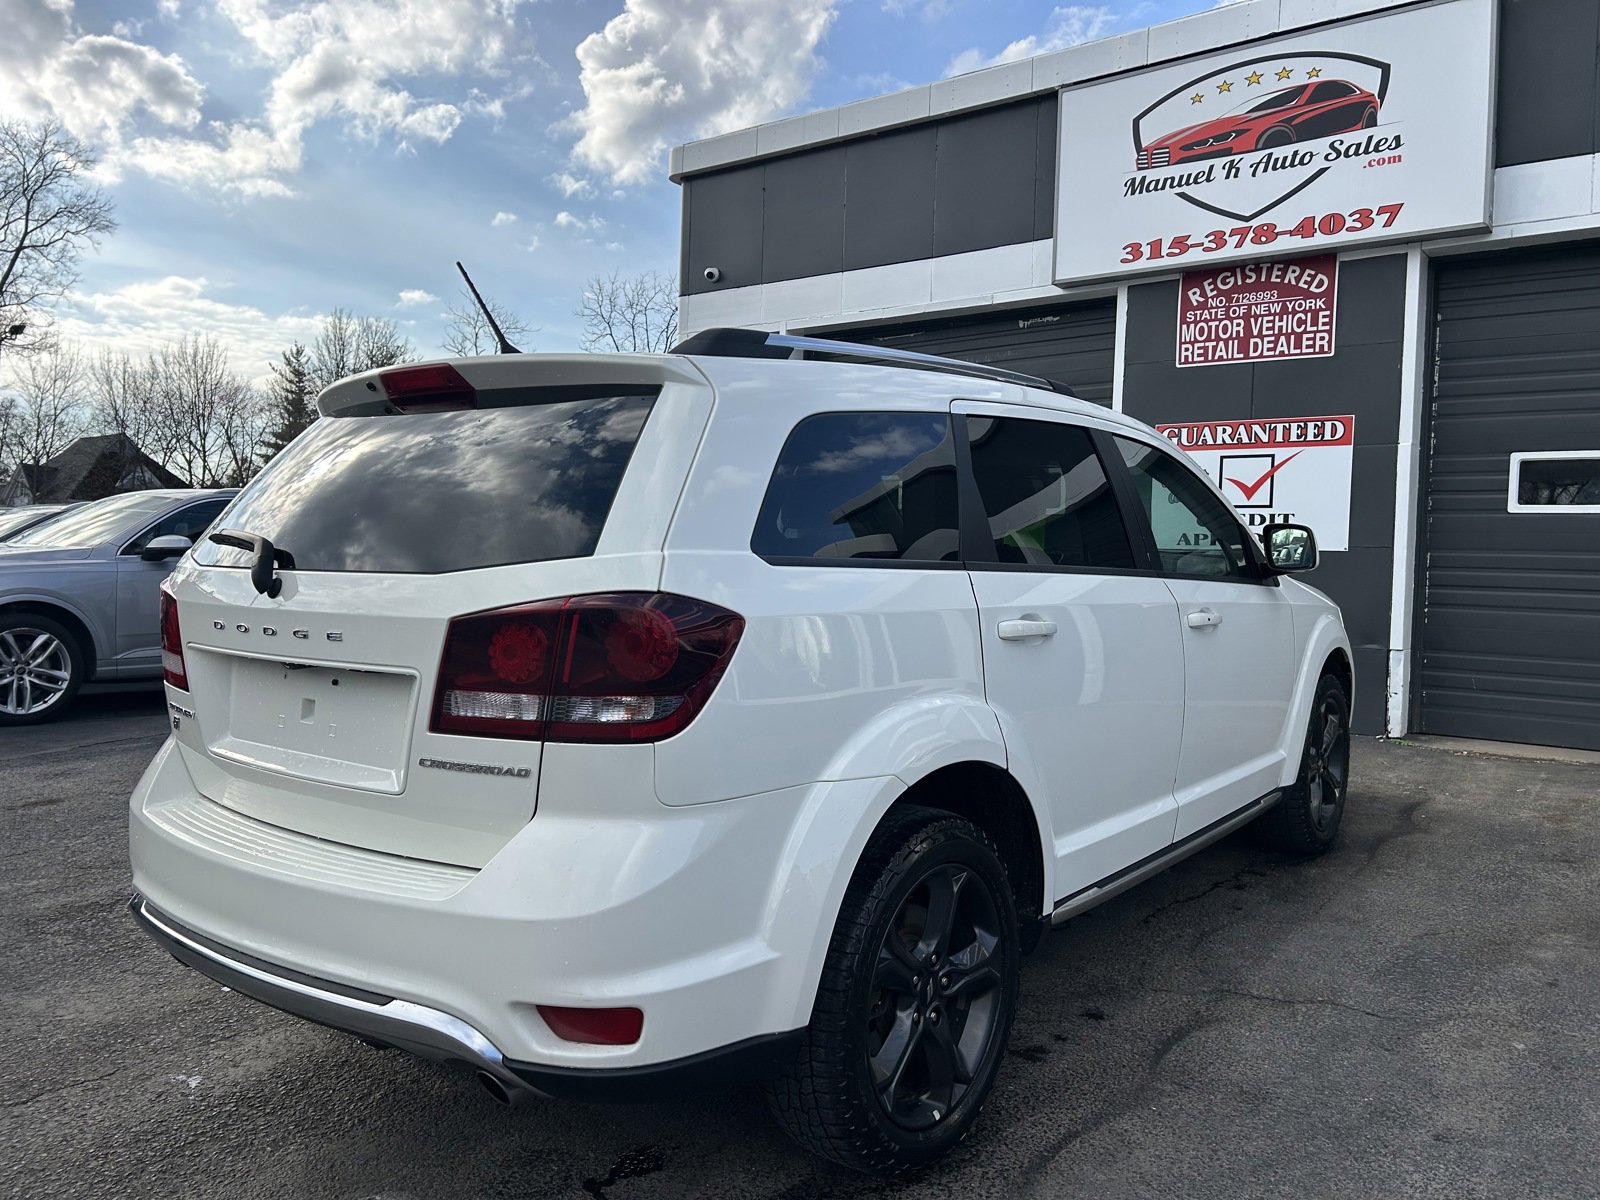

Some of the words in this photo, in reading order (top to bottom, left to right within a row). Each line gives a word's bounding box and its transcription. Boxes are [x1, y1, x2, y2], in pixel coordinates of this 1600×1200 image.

[1123, 164, 1216, 197] Manuel
[1221, 157, 1244, 180] K
[1249, 149, 1320, 178] Auto
[1323, 134, 1405, 162] Sales
[1363, 154, 1402, 169] .com
[1120, 202, 1405, 264] 315-378-4037
[1187, 262, 1329, 306] REGISTERED
[1186, 308, 1226, 322] STATE
[1229, 305, 1248, 318] OF
[1251, 302, 1283, 316] NEW
[1286, 298, 1326, 312] YORK
[1207, 296, 1229, 308] NO.
[1231, 290, 1278, 304] 7126993
[1181, 319, 1244, 342] MOTOR
[1250, 310, 1330, 336] VEHICLE
[1180, 339, 1244, 363] RETAIL
[1249, 332, 1330, 357] DEALER
[1161, 420, 1346, 447] GUARANTEED
[213, 619, 343, 642] DODGE
[418, 757, 532, 778] CROSSROAD
